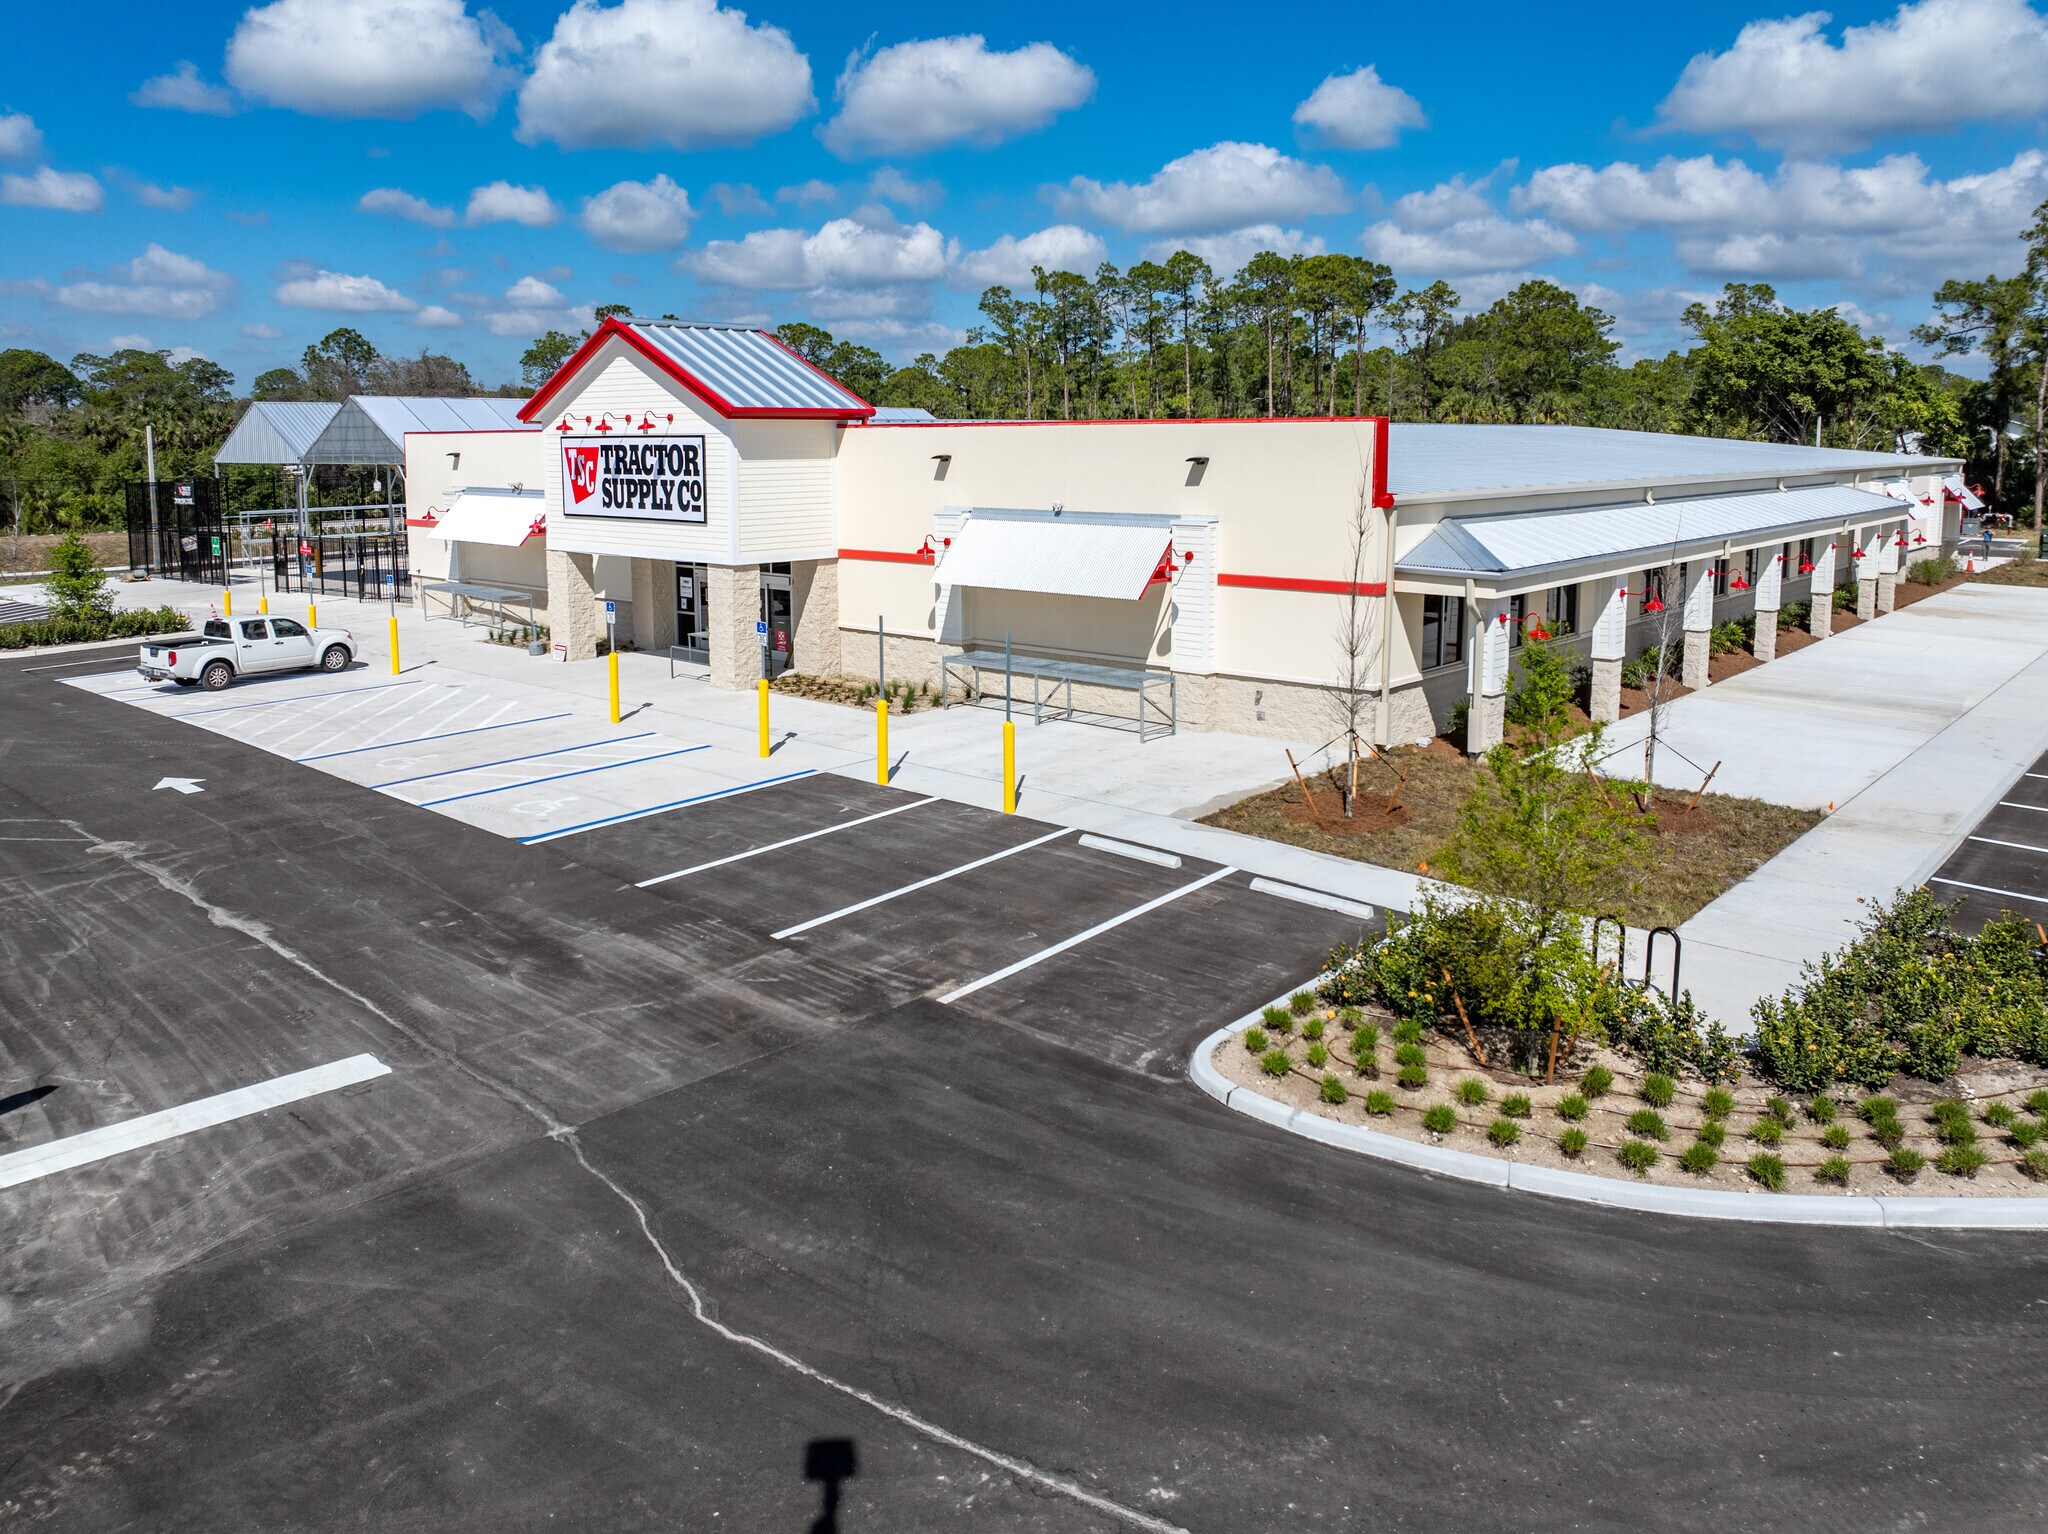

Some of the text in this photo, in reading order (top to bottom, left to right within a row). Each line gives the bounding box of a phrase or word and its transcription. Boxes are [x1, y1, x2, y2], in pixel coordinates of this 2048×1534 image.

[567, 448, 595, 494] TSC
[600, 443, 701, 477] TRACTOR
[601, 477, 676, 511] SUPPLY
